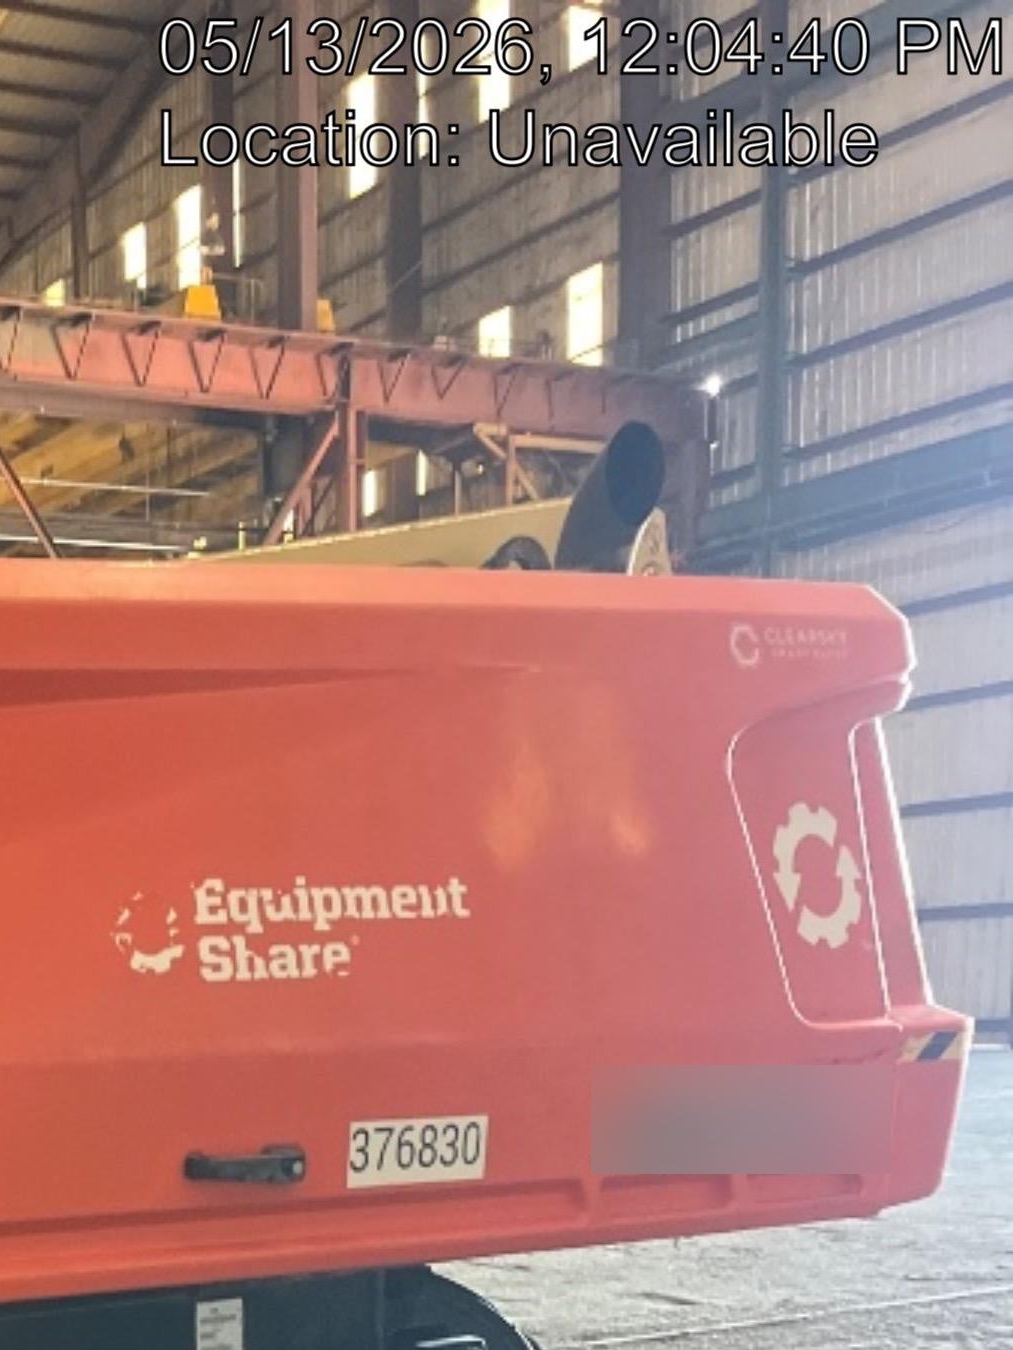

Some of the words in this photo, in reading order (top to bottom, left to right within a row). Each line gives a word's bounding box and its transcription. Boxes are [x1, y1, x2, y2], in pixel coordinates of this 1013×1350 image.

[193, 875, 471, 933] Equipment
[198, 935, 352, 982] Share
[349, 1121, 481, 1173] 376830
